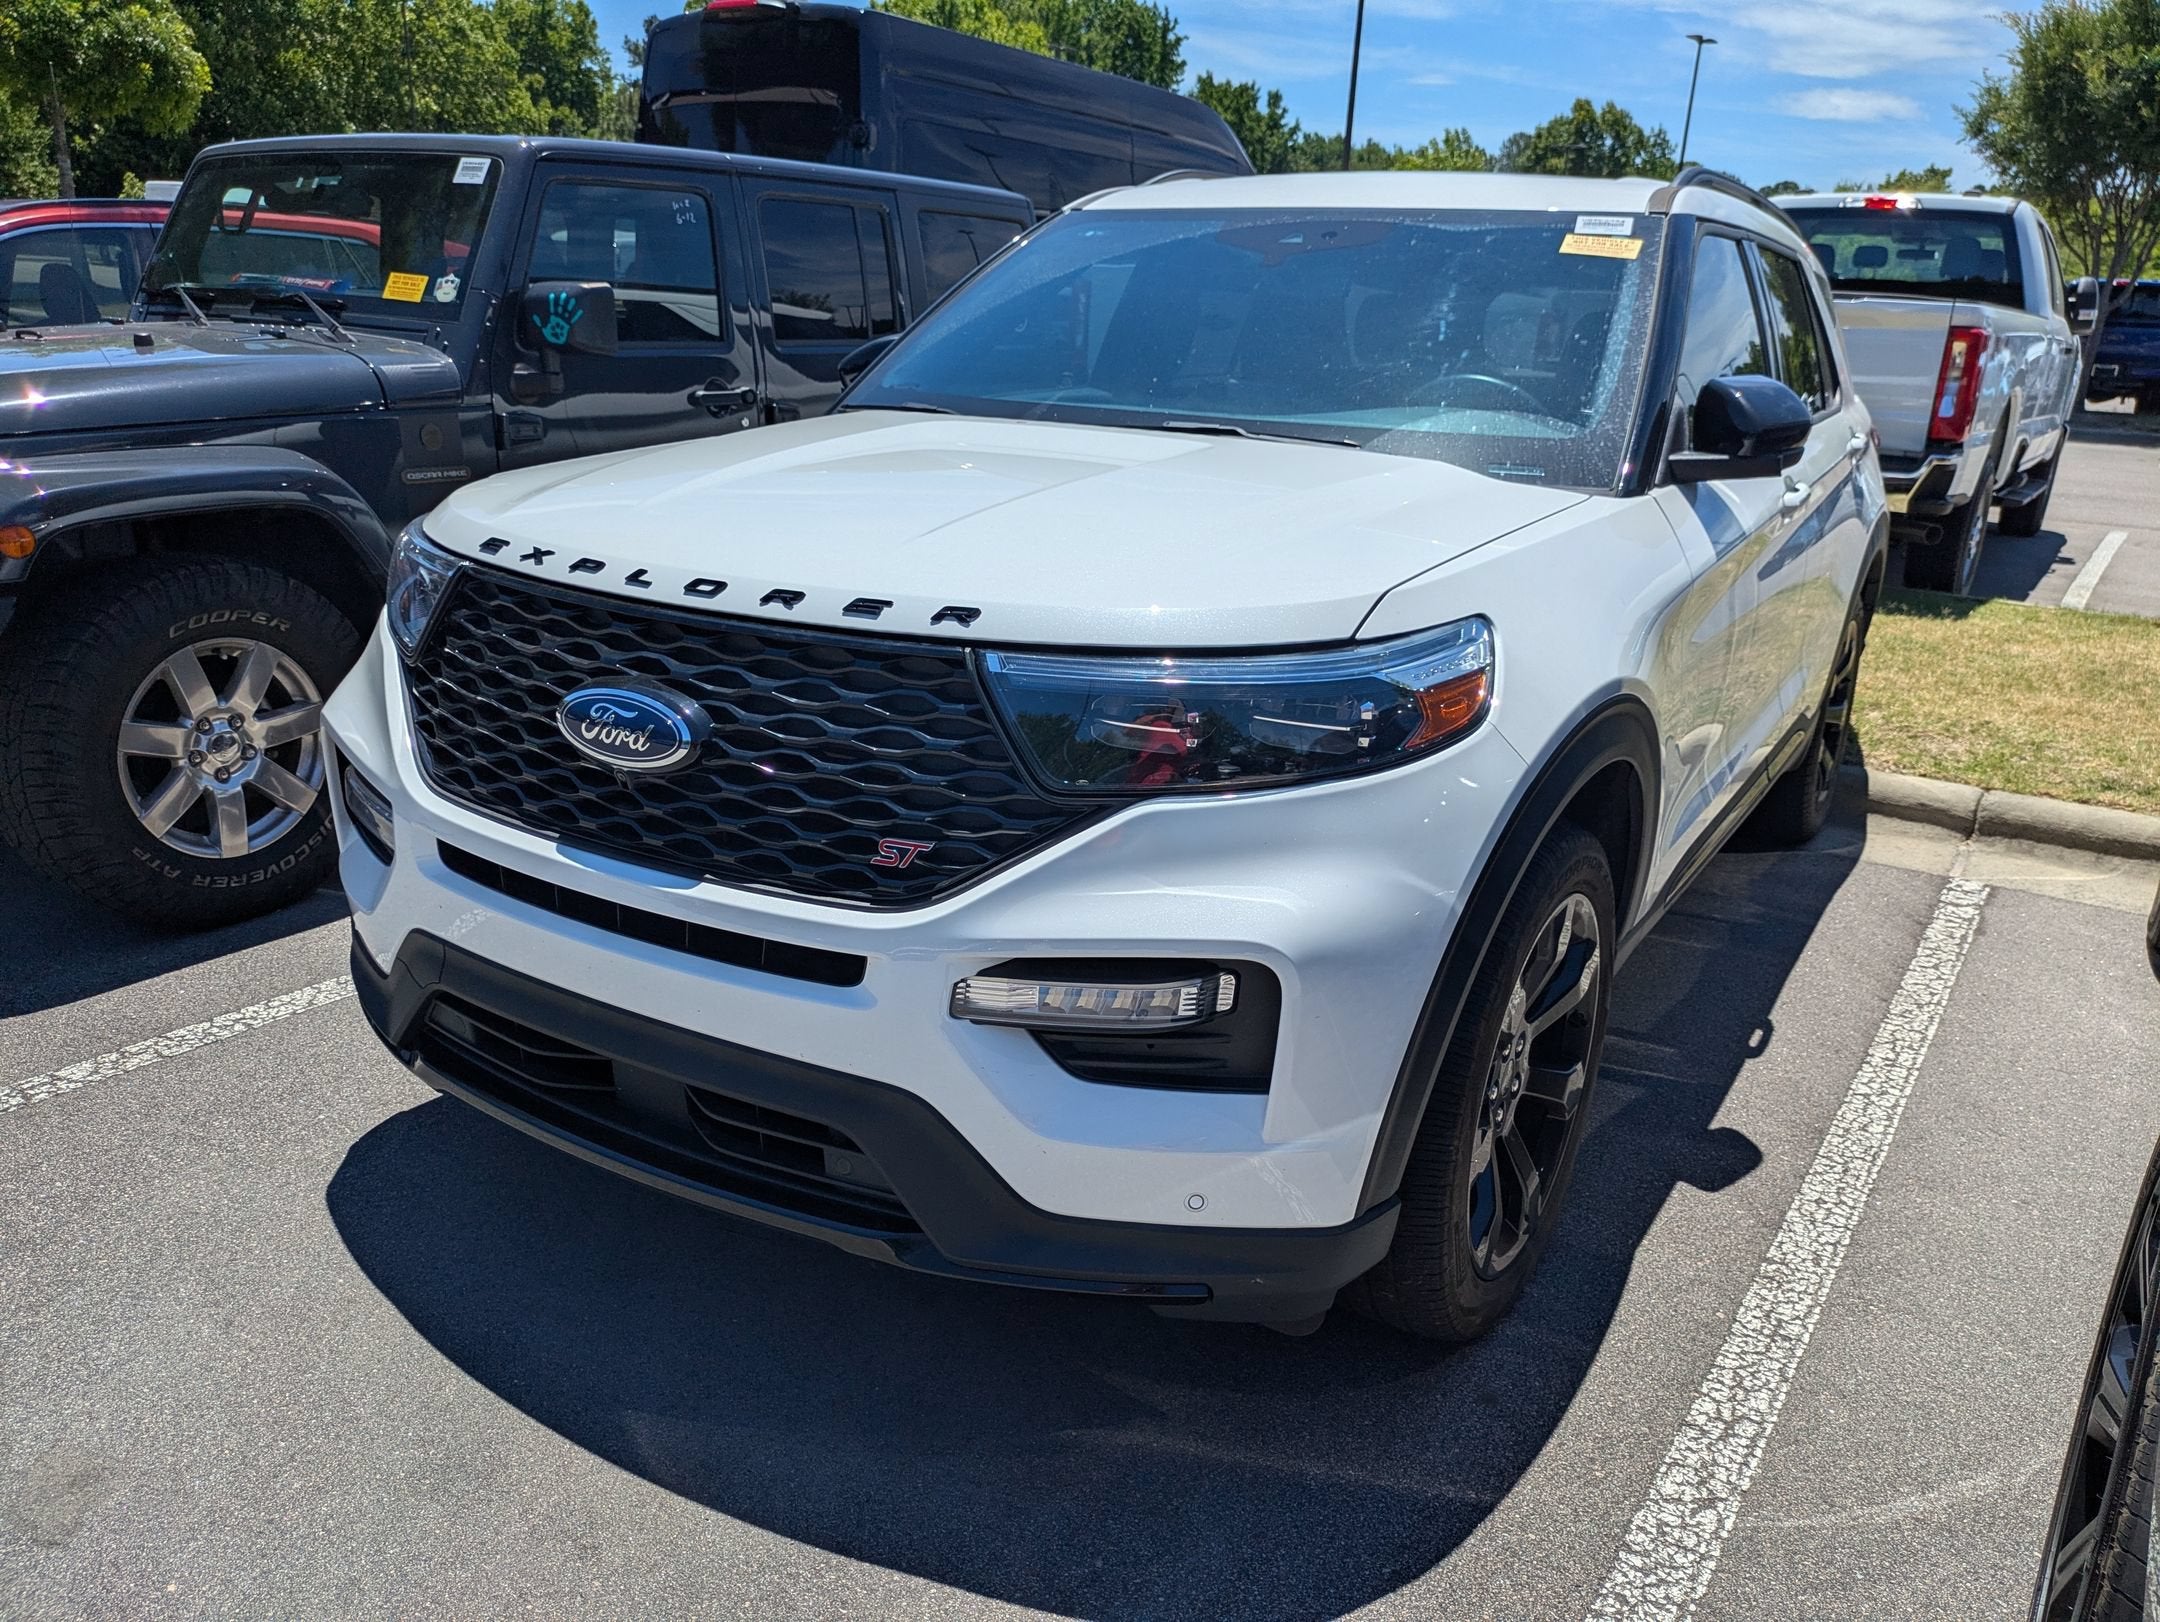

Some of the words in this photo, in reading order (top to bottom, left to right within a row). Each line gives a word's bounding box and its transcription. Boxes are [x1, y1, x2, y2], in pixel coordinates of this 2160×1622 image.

[407, 471, 442, 480] OSCAR
[478, 536, 983, 628] EXPLORER
[169, 609, 290, 638] COOPER
[580, 702, 655, 752] Ford
[192, 812, 333, 888] DISCOVERER
[869, 838, 936, 869] ST
